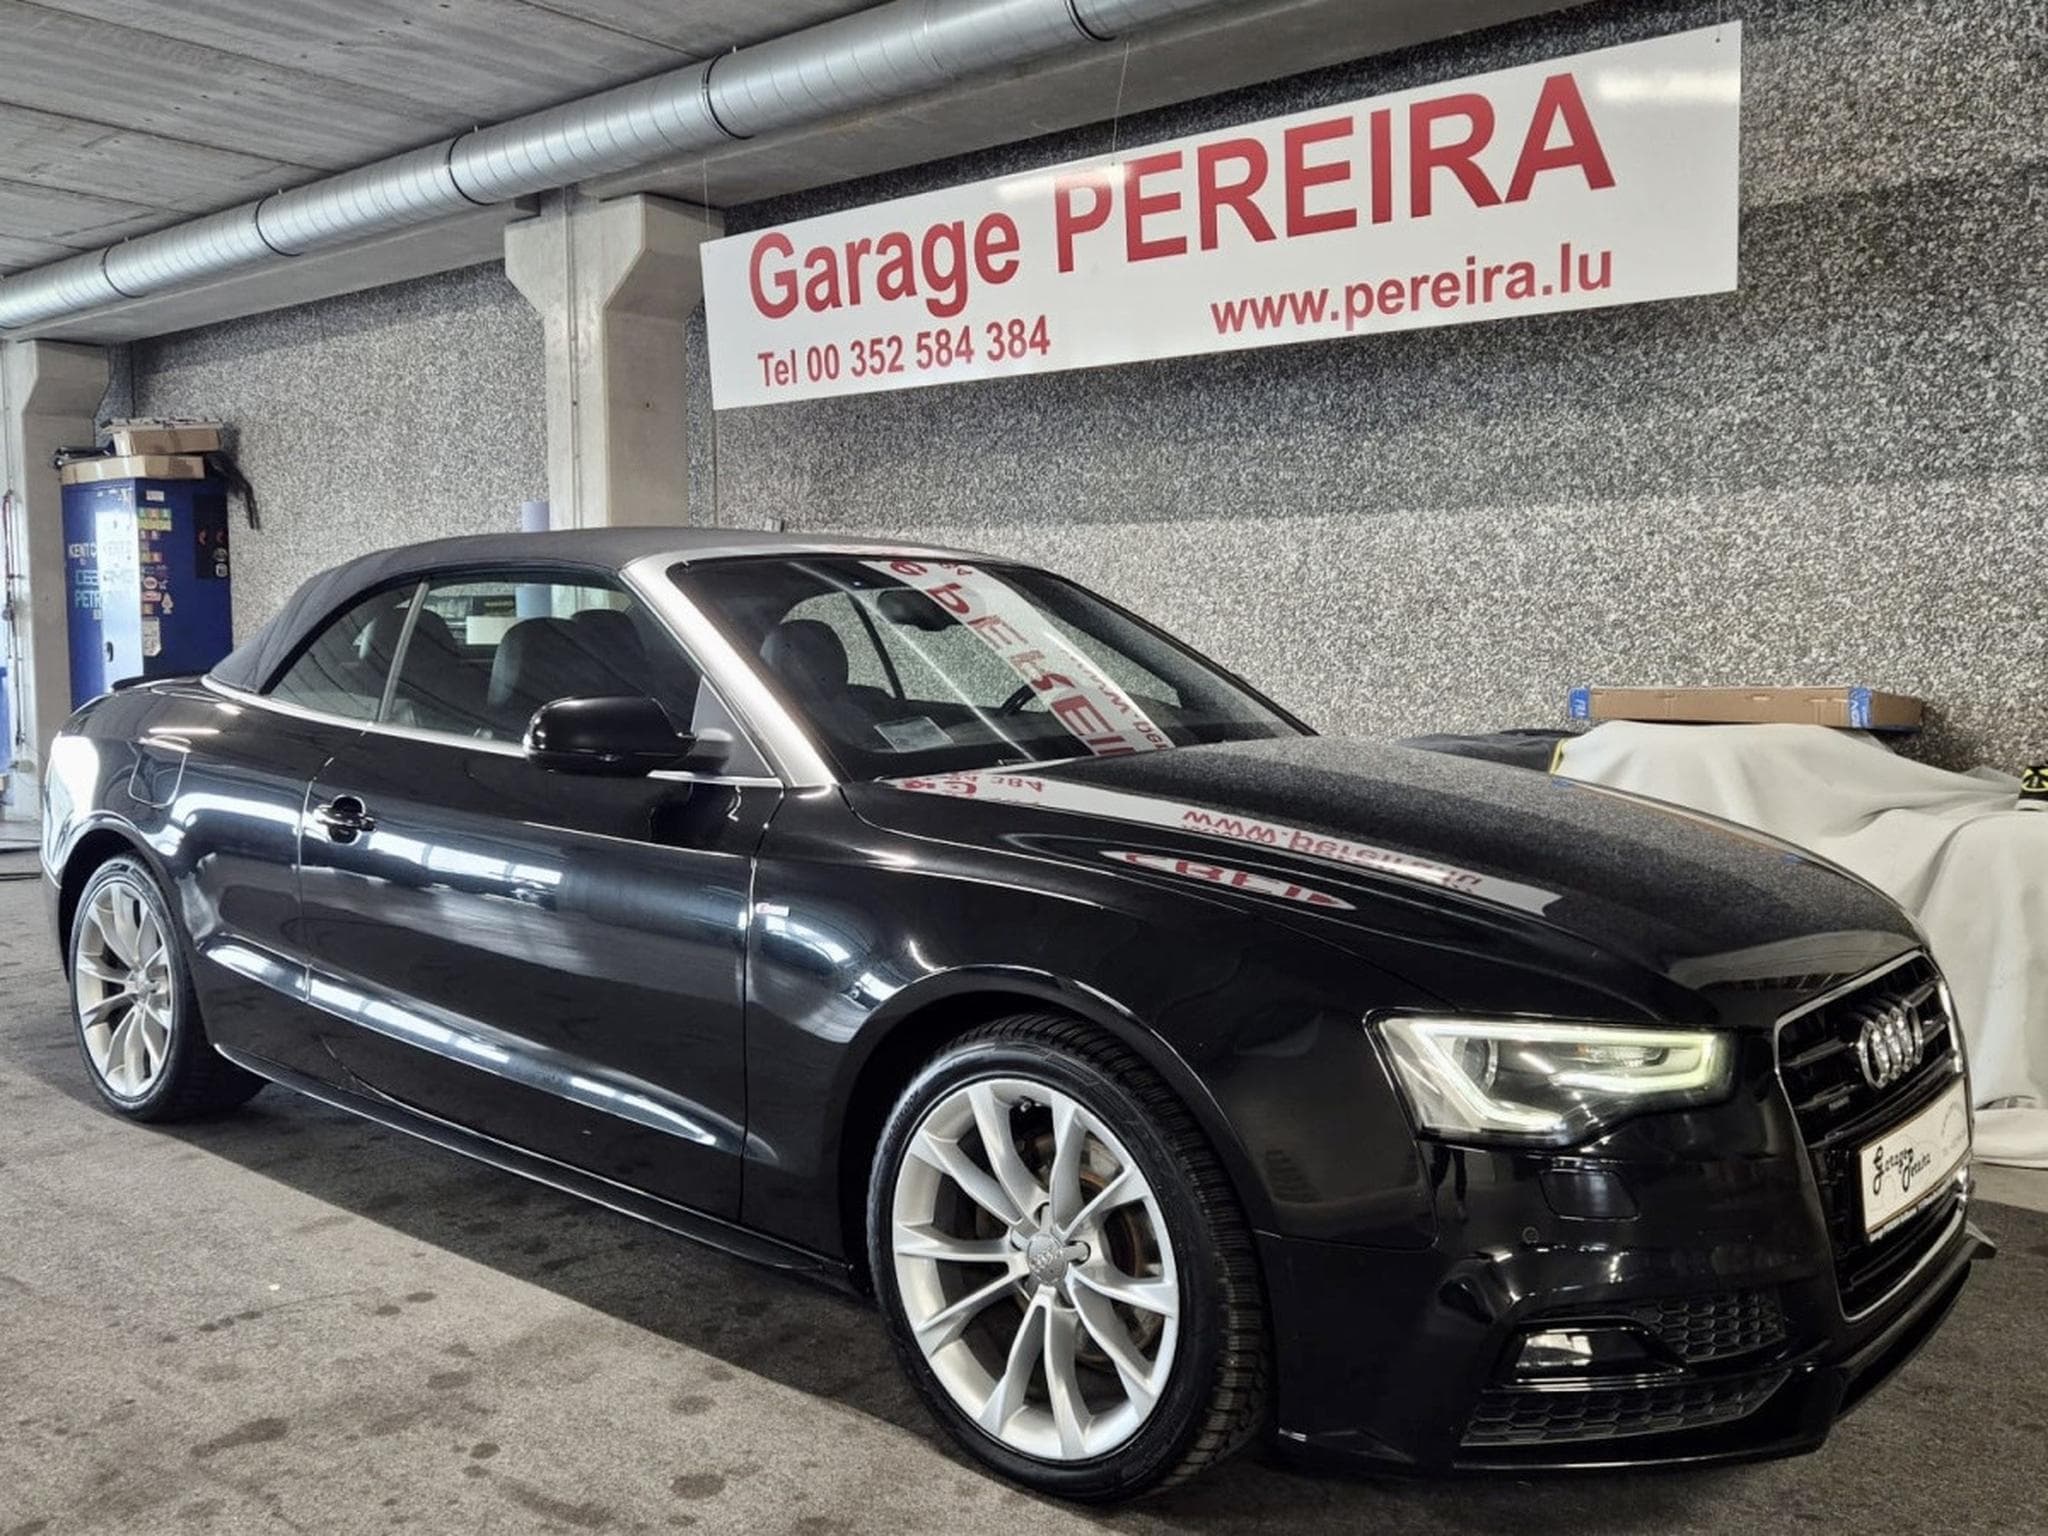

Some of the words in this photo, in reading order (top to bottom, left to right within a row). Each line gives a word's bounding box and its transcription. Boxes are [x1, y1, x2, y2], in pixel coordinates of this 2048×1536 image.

[749, 212, 1021, 320] Garage
[1054, 73, 1616, 274] PEREIRA
[1211, 243, 1613, 335] www.pereira.lu
[757, 348, 797, 387] Tel
[807, 345, 840, 383] 00
[850, 335, 904, 379] 352
[915, 327, 975, 370] 584
[986, 315, 1051, 363] 384
